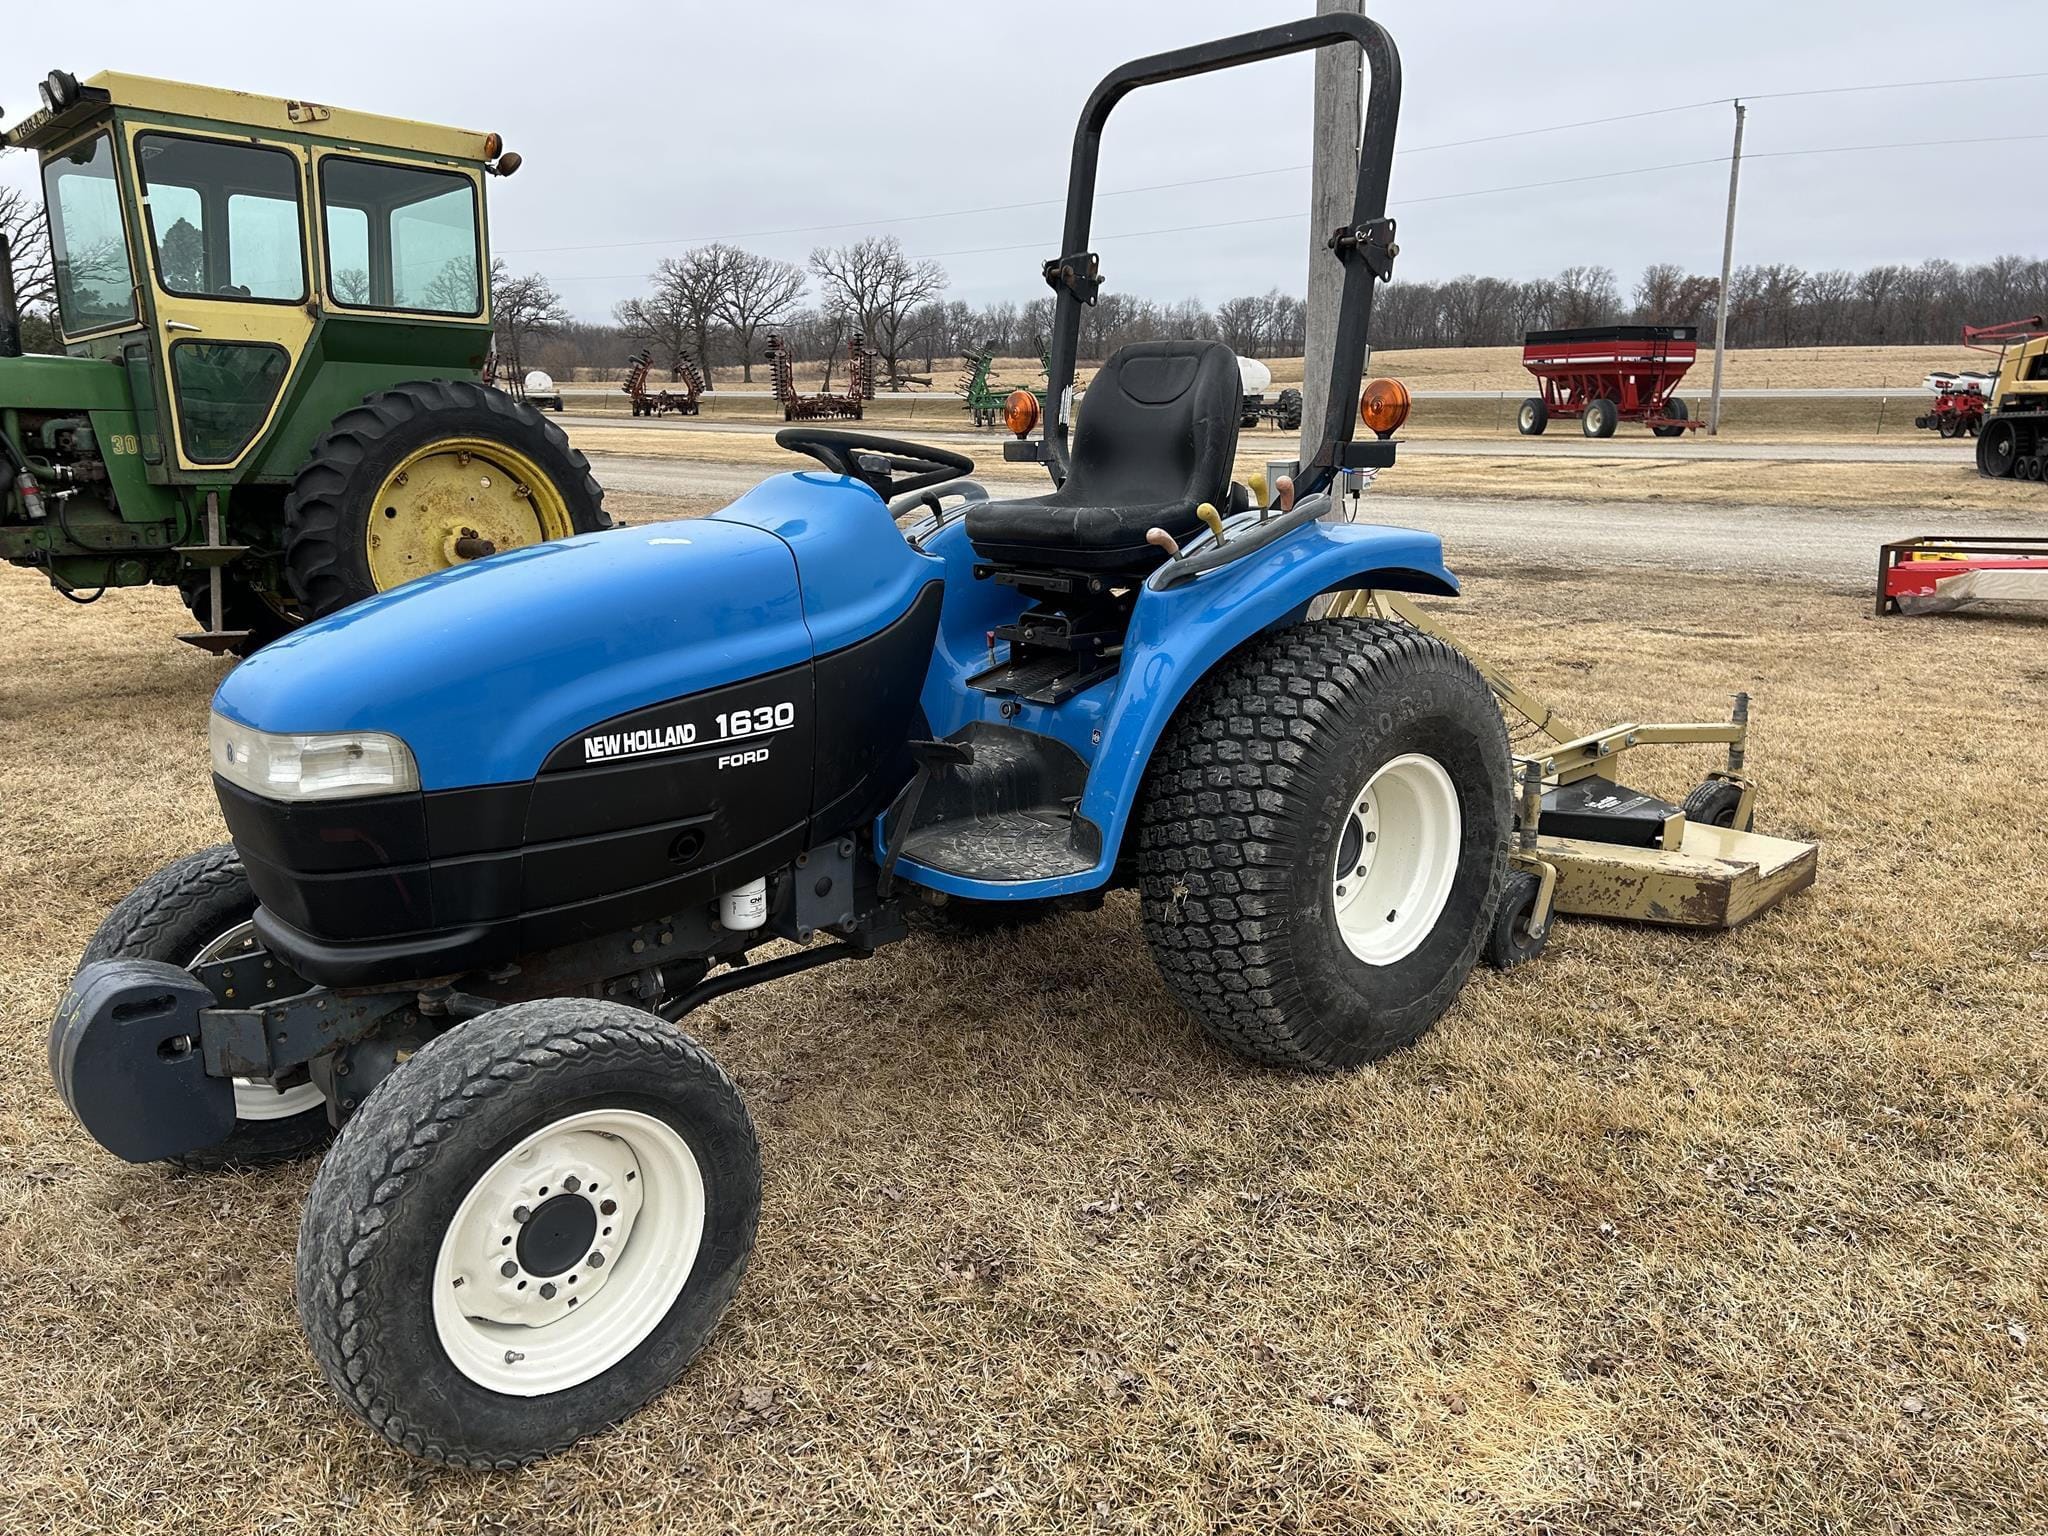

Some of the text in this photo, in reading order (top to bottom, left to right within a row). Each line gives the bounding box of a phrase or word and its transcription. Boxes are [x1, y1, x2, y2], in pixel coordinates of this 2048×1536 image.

[584, 702, 795, 758] NEW HOLLAND 1630
[718, 748, 769, 770] FORD
